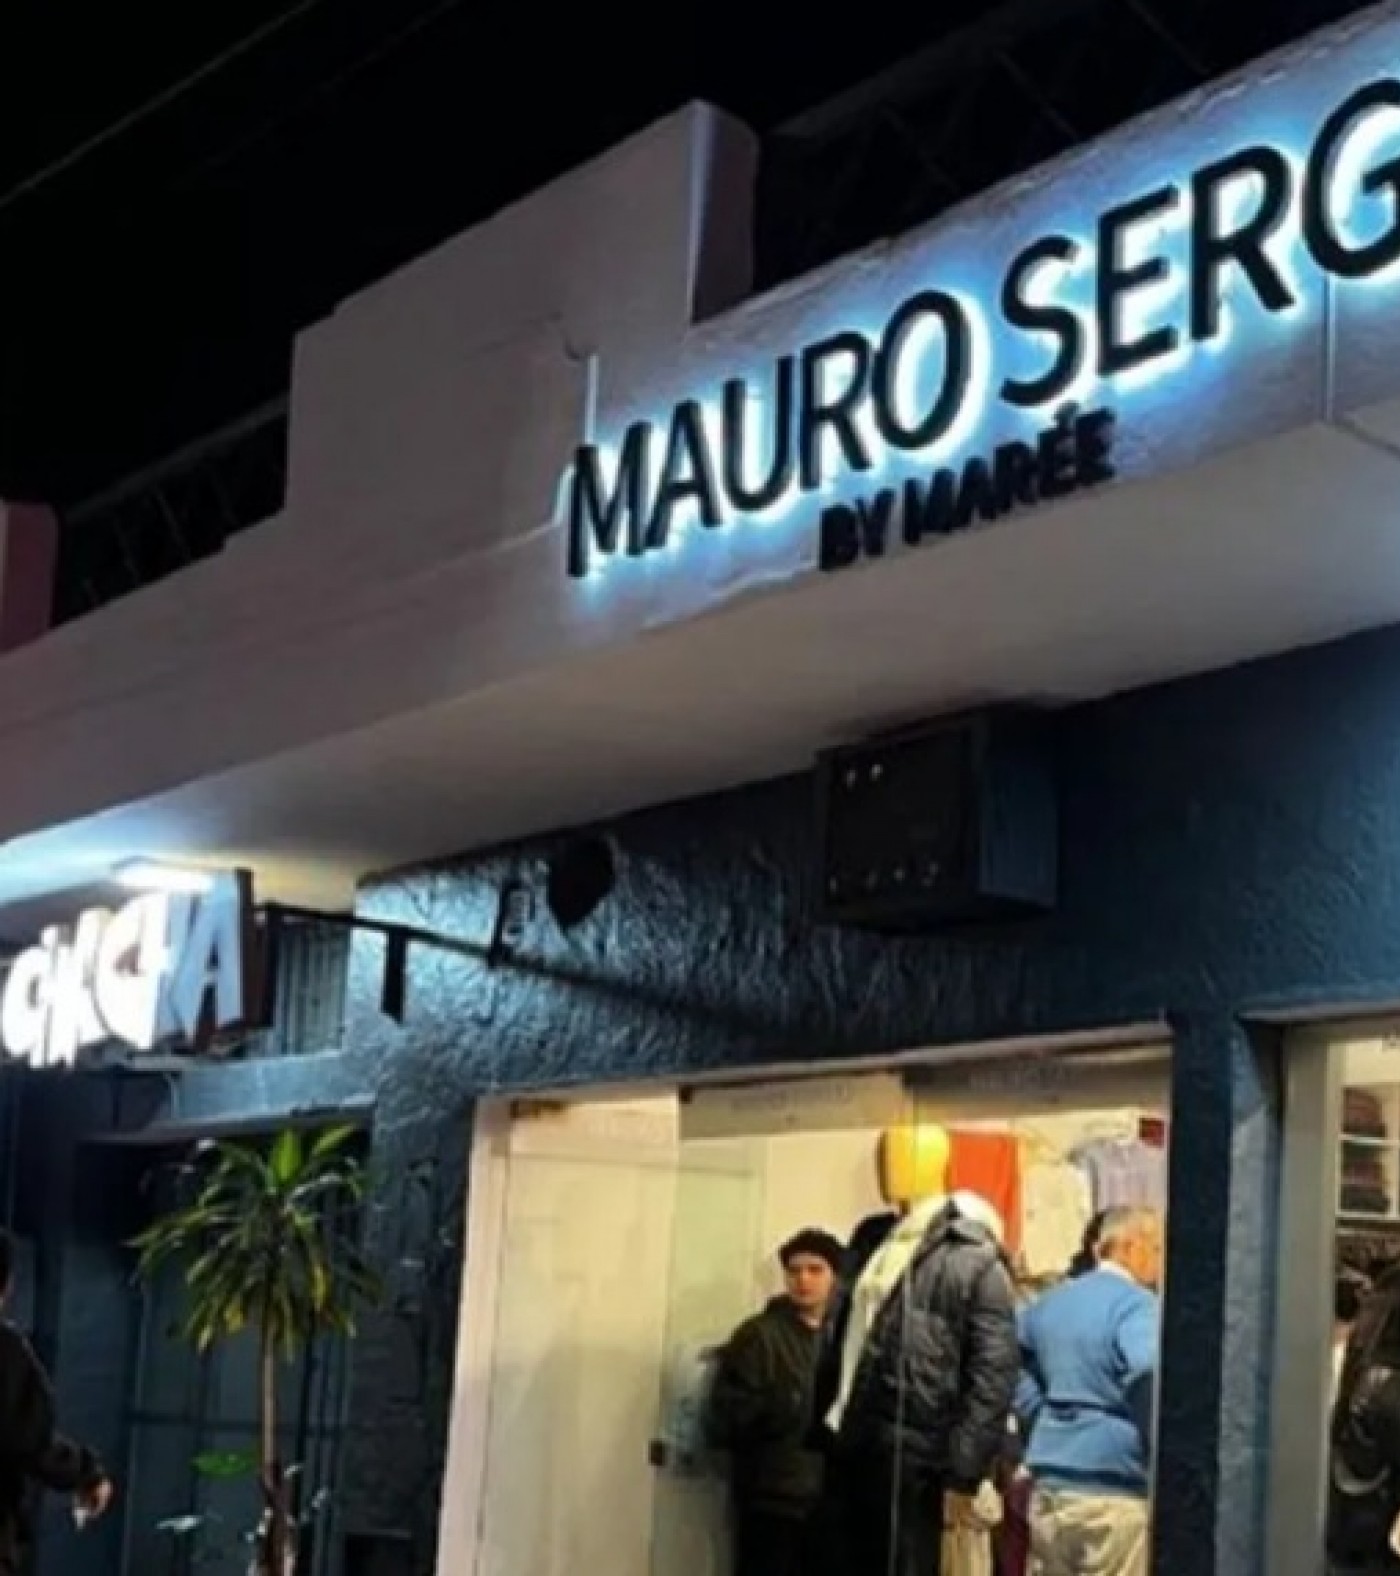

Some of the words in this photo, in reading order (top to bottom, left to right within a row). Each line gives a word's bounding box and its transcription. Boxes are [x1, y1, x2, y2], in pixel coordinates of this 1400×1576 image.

[566, 288, 972, 577] MAURO
[819, 487, 896, 572] BY
[902, 401, 1118, 546] MARÉE
